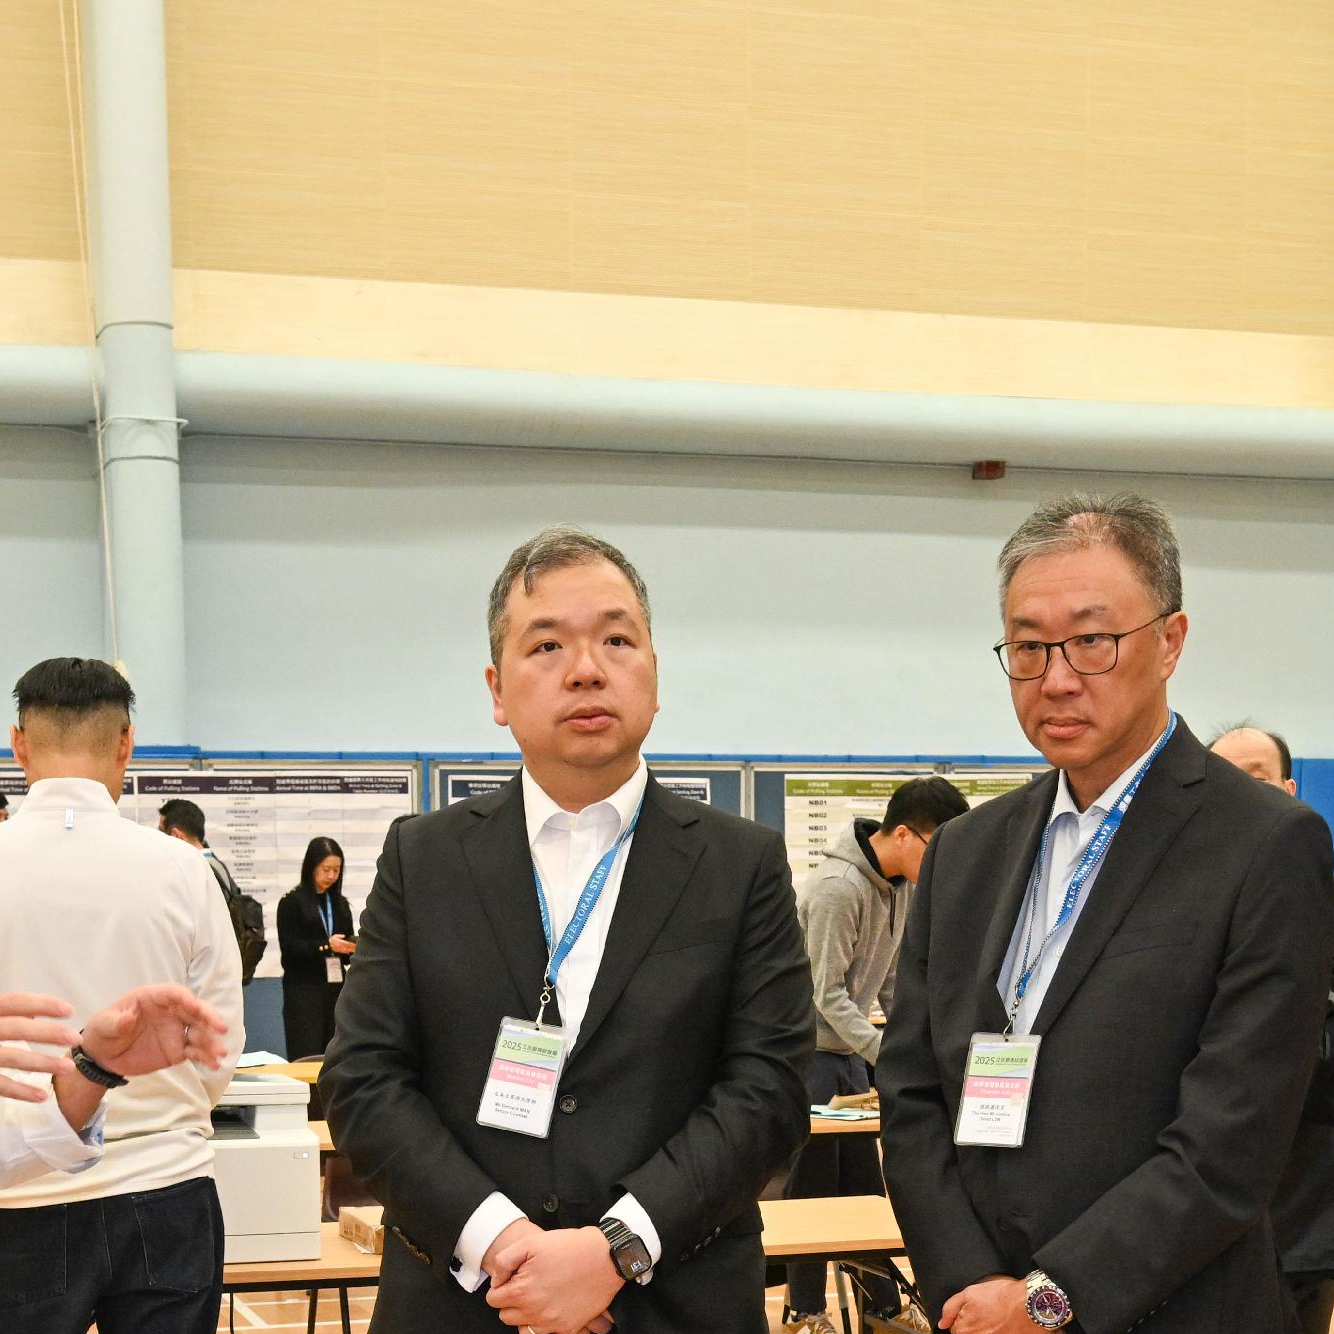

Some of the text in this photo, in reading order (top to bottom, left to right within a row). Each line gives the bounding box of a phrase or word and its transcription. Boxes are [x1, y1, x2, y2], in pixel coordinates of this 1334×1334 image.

[1067, 824, 1111, 909] ELECTORAL STAFF
[565, 865, 607, 944] ELECTORAL STAFF
[502, 1040, 522, 1051] 2025
[975, 1056, 995, 1065] 2025
